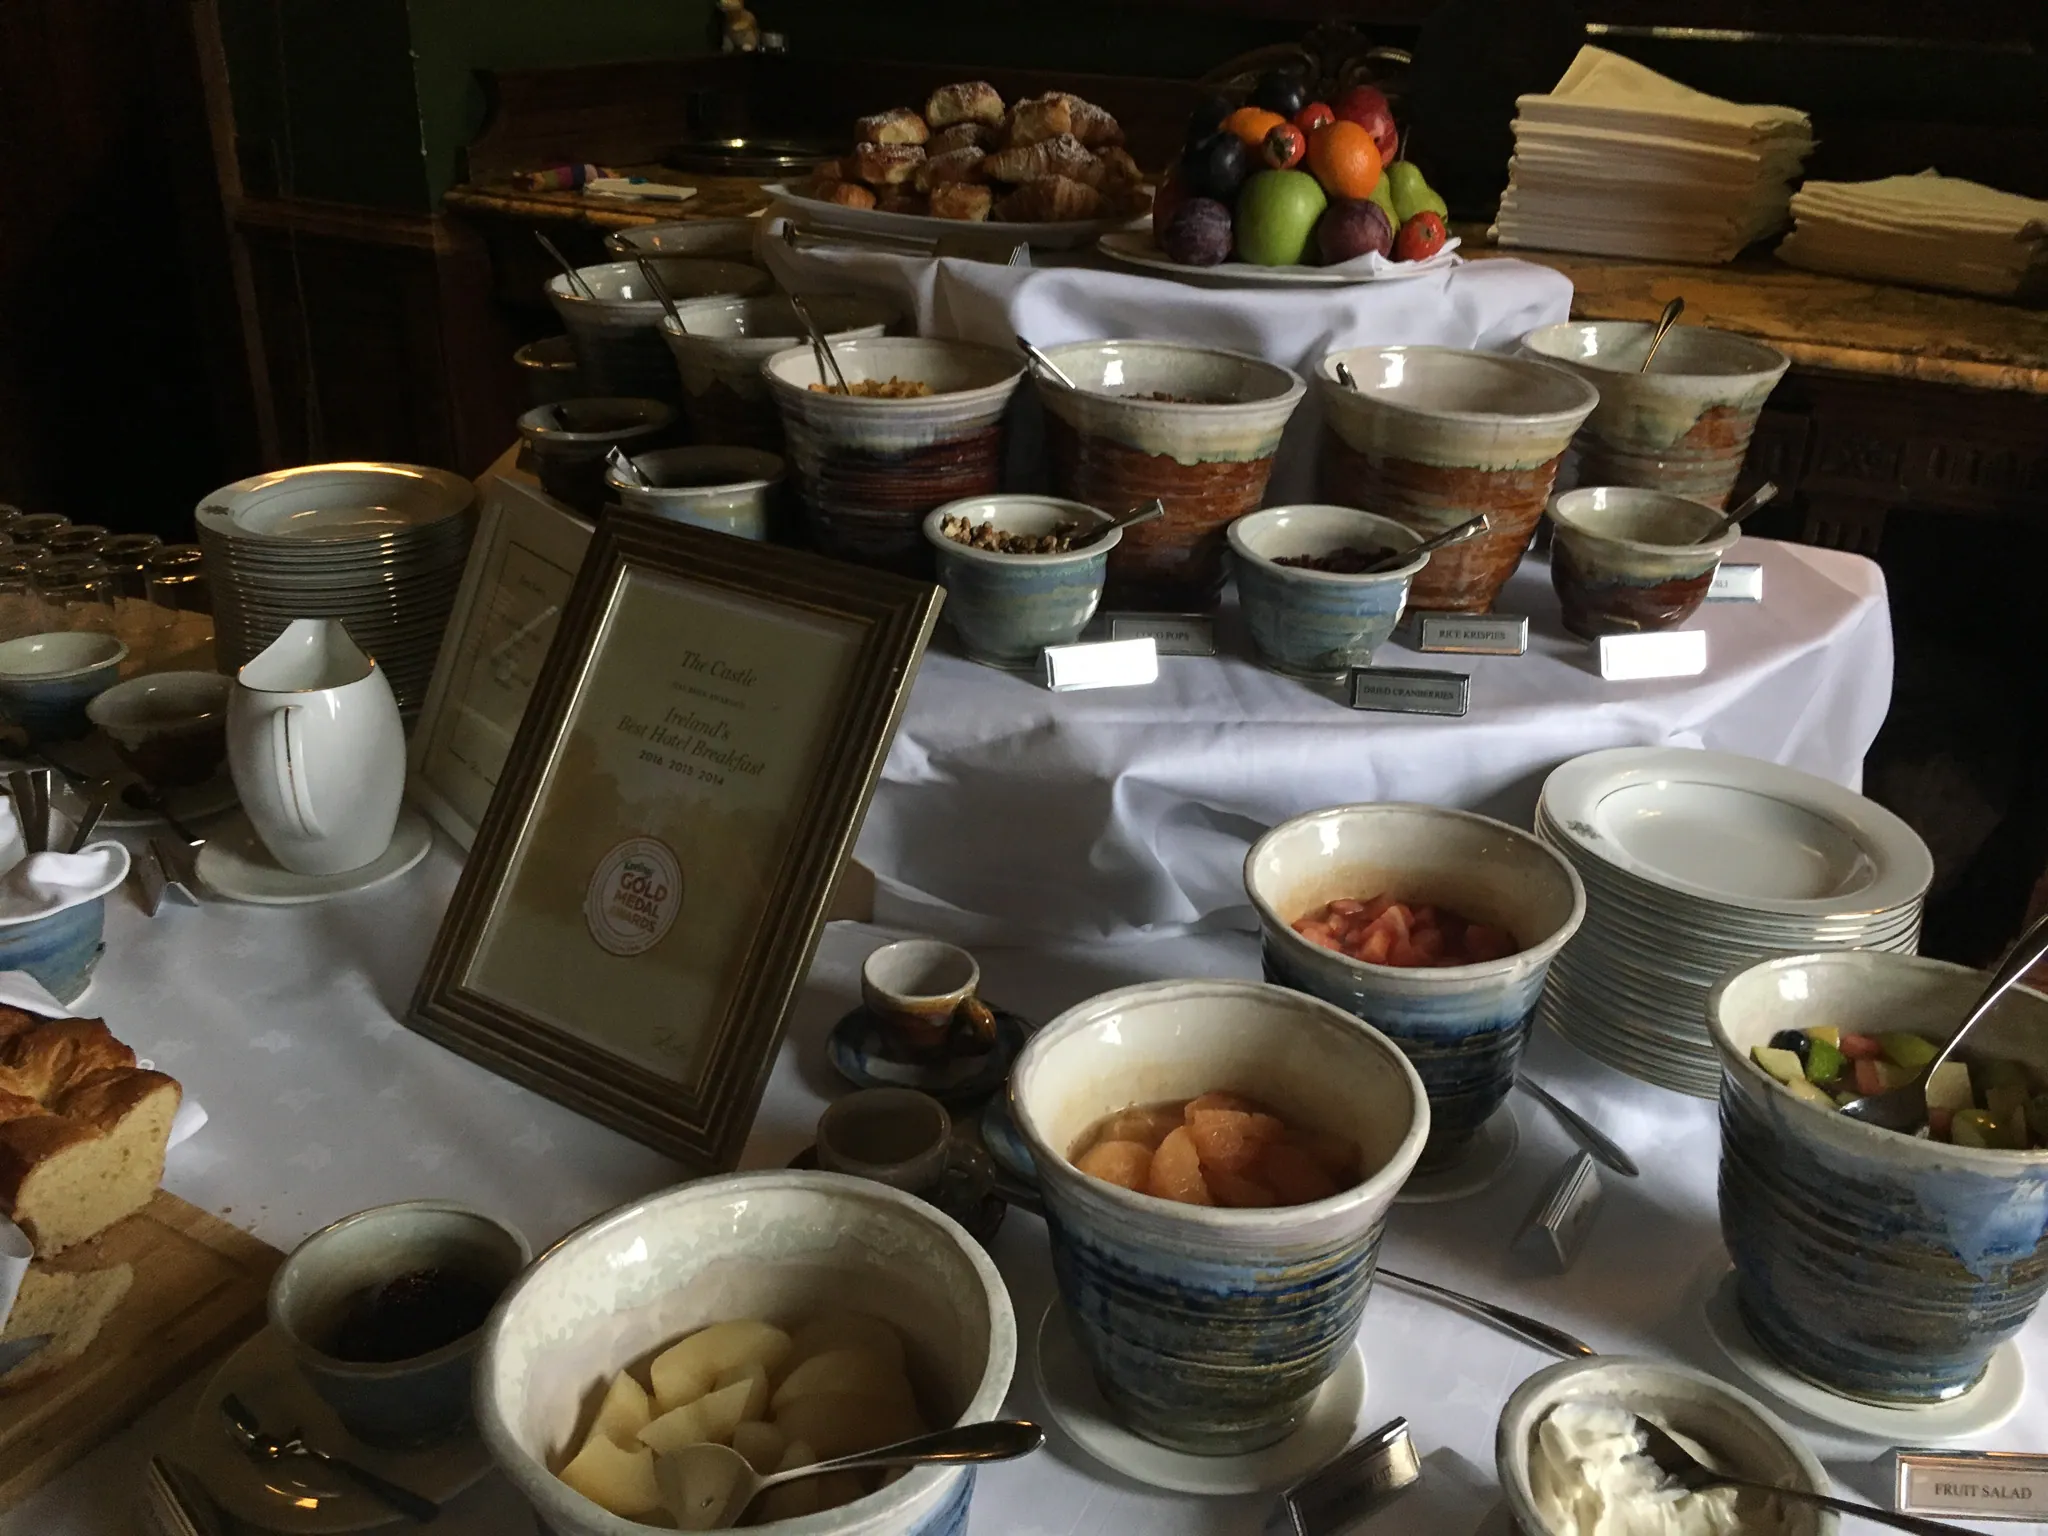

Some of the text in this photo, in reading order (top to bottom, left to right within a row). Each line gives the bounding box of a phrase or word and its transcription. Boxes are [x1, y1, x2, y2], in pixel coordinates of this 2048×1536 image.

[1165, 631, 1190, 642] POPS
[1438, 628, 1506, 641] RICE KRISPIES
[681, 649, 758, 687] The Castle
[1363, 685, 1455, 701] DRIED CRANBERRIES
[664, 706, 731, 742] Ireland's
[616, 714, 766, 776] Best Hotel Breakfast
[638, 749, 725, 787] 2016 2015 2014
[620, 872, 667, 902] GOLD
[613, 889, 659, 919] MEDAL
[1934, 1482, 2032, 1500] FRUIT SALAD
